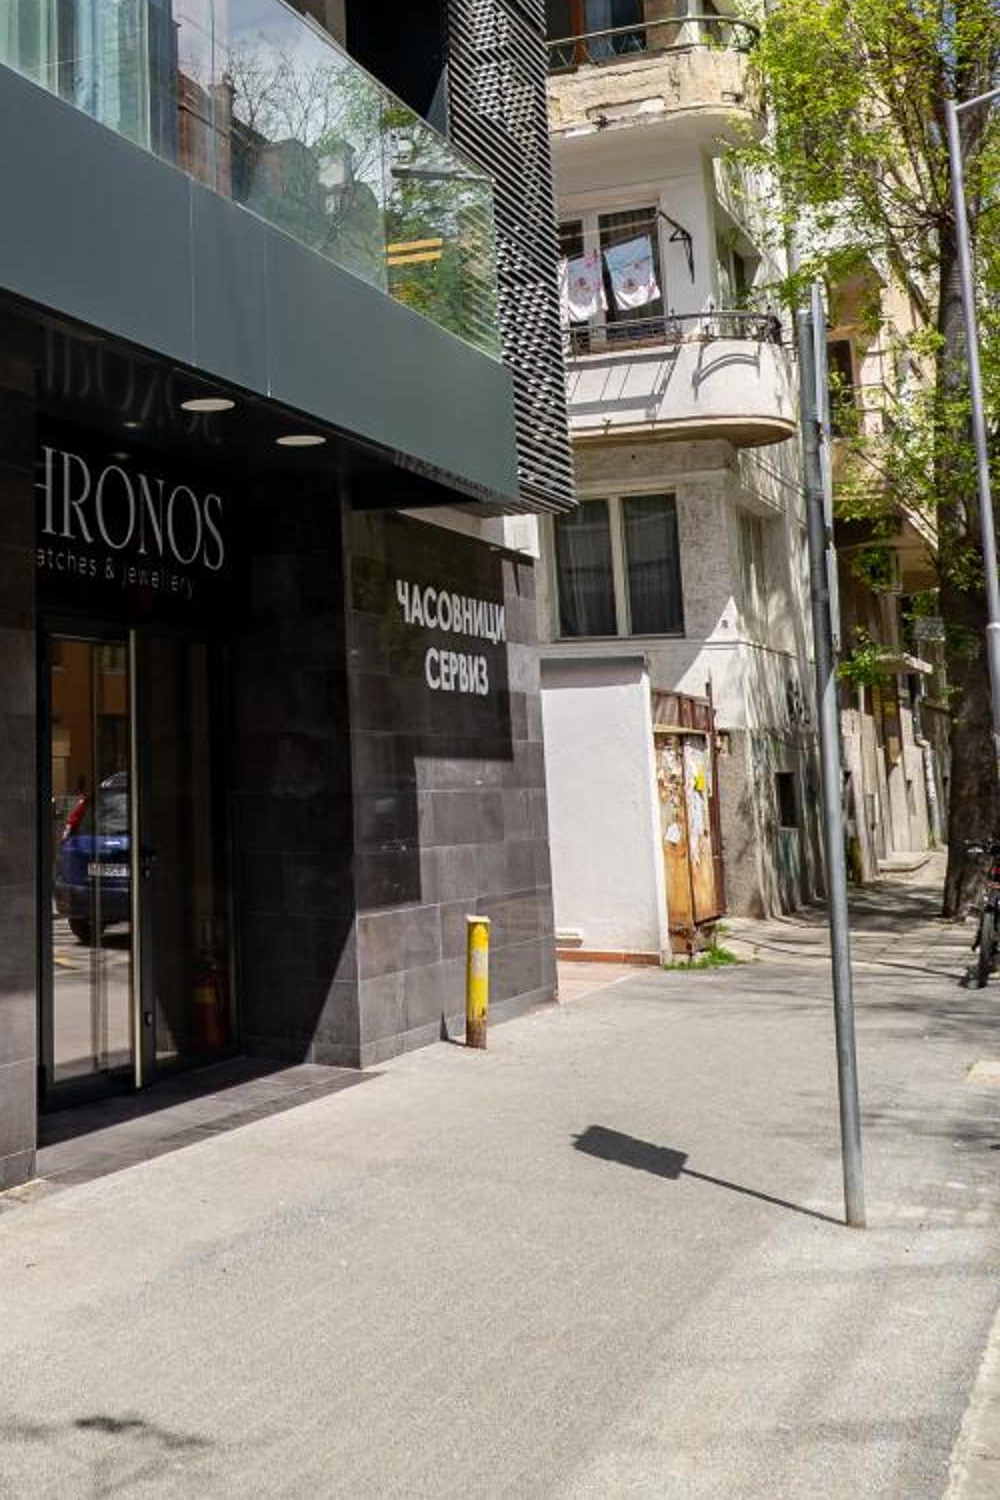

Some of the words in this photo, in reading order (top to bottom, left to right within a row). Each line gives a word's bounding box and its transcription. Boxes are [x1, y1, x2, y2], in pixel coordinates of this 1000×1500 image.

[105, 556, 115, 579] &
[396, 579, 506, 644] ЧАСОВНИЦИ
[425, 647, 489, 696] СЕРВИЗ
